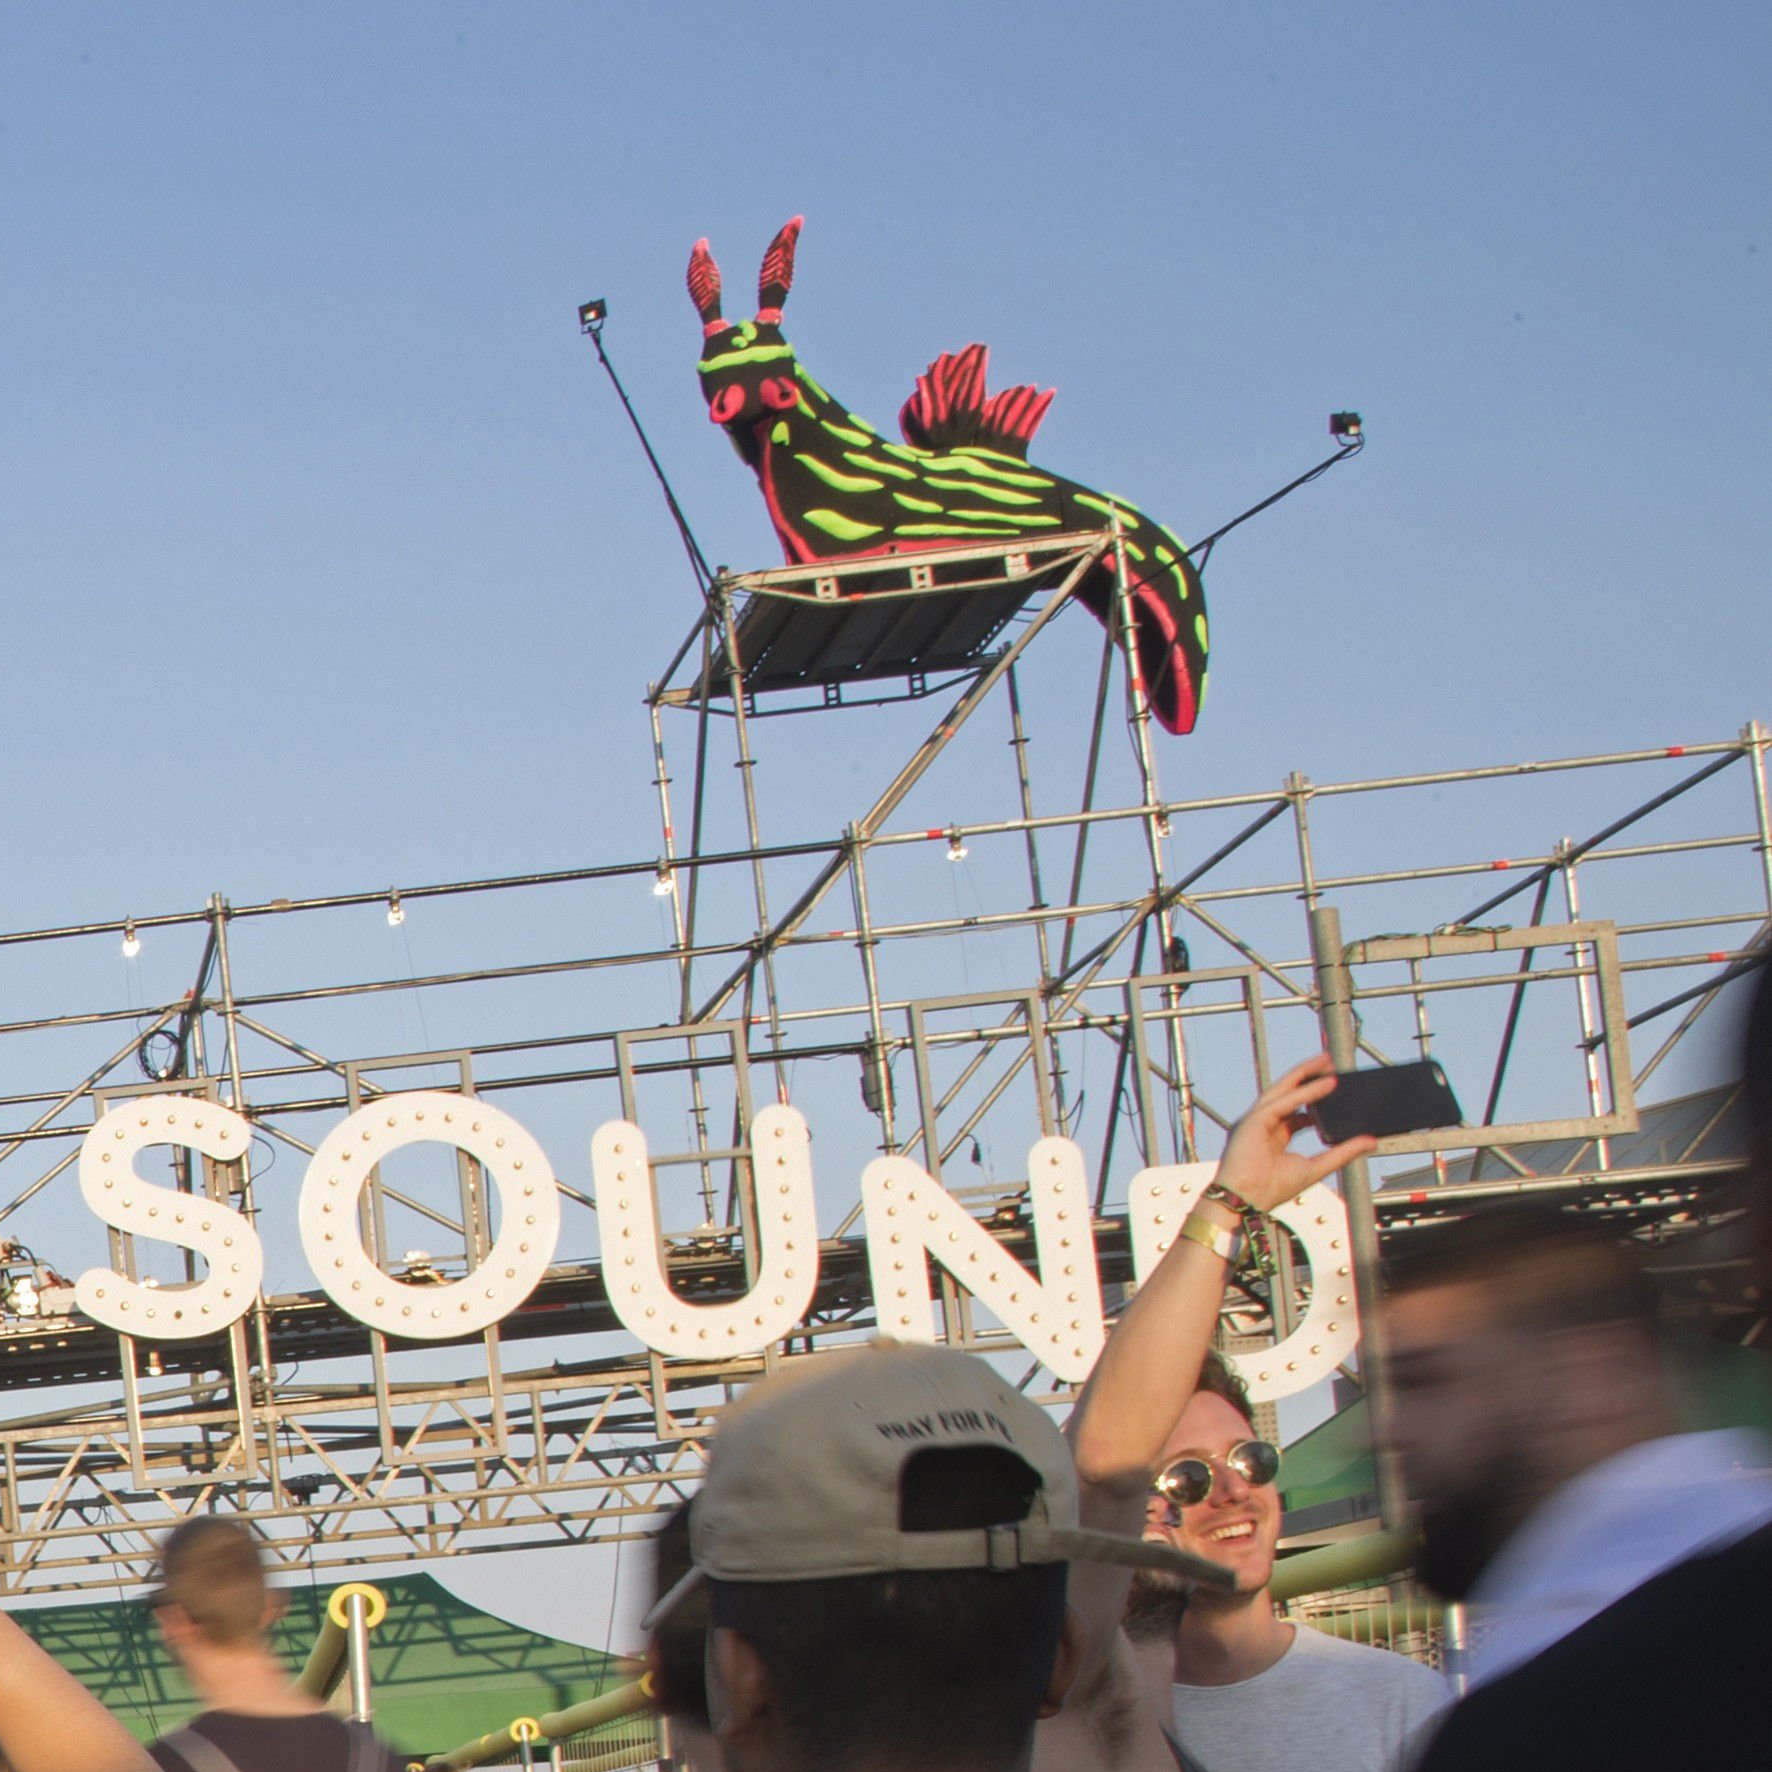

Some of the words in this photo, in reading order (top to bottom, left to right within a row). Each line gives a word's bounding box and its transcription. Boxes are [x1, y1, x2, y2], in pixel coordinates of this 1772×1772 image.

[76, 1088, 1362, 1400] SOUND
[875, 1412, 934, 1440] PRAY
[937, 1408, 986, 1434] FOR
